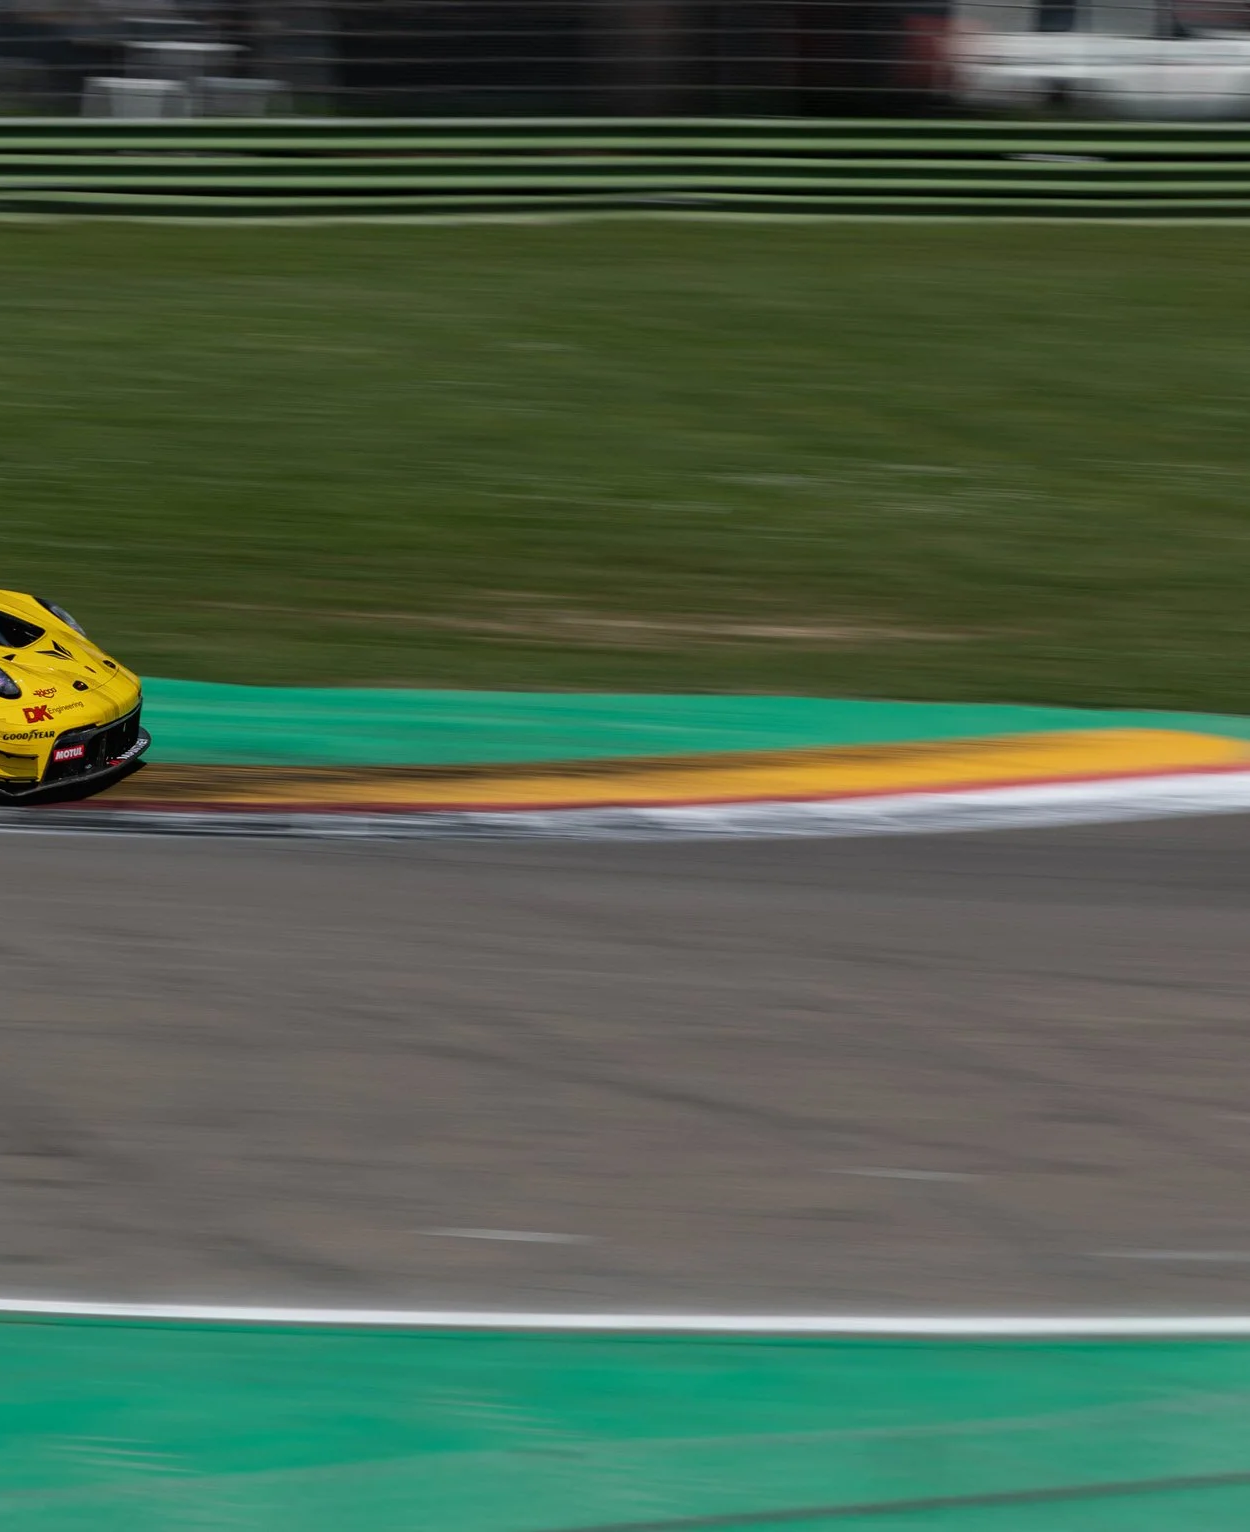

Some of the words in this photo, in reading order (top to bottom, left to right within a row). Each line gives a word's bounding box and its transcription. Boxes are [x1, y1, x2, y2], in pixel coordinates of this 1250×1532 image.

[22, 705, 54, 724] DK
[47, 701, 84, 715] Engineering
[3, 729, 55, 742] GOODYEAR
[55, 747, 83, 760] MOTUL
